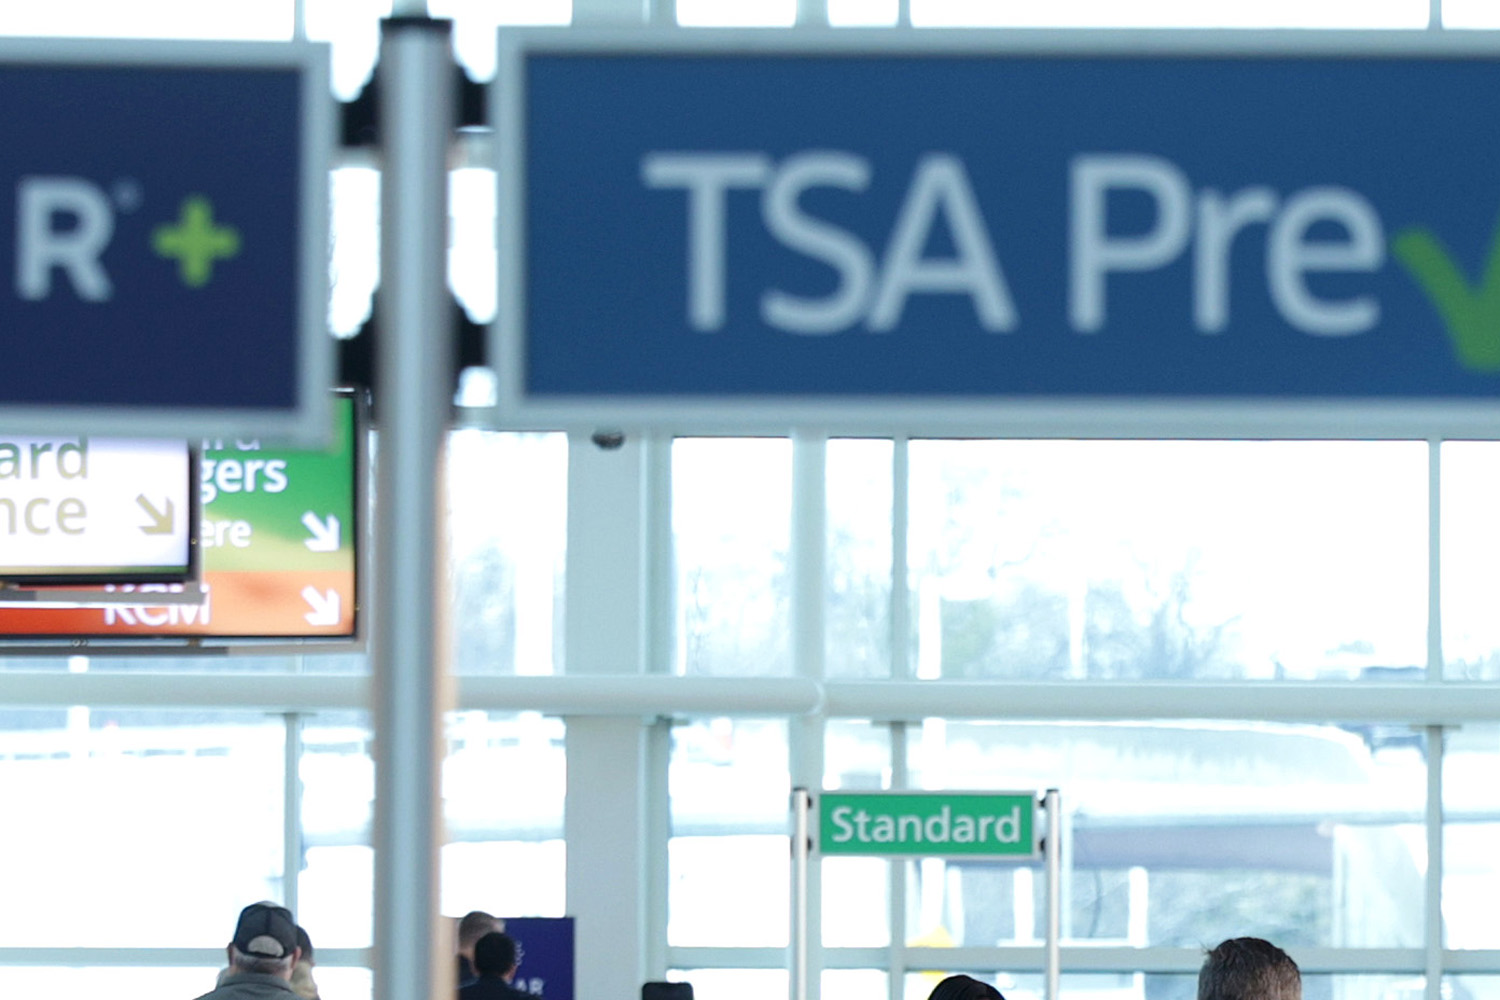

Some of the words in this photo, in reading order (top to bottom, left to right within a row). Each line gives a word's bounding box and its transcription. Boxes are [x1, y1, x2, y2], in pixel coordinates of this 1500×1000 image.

[640, 149, 1018, 336] TSA
[1067, 151, 1387, 337] Pre
[830, 805, 1021, 844] Standard
